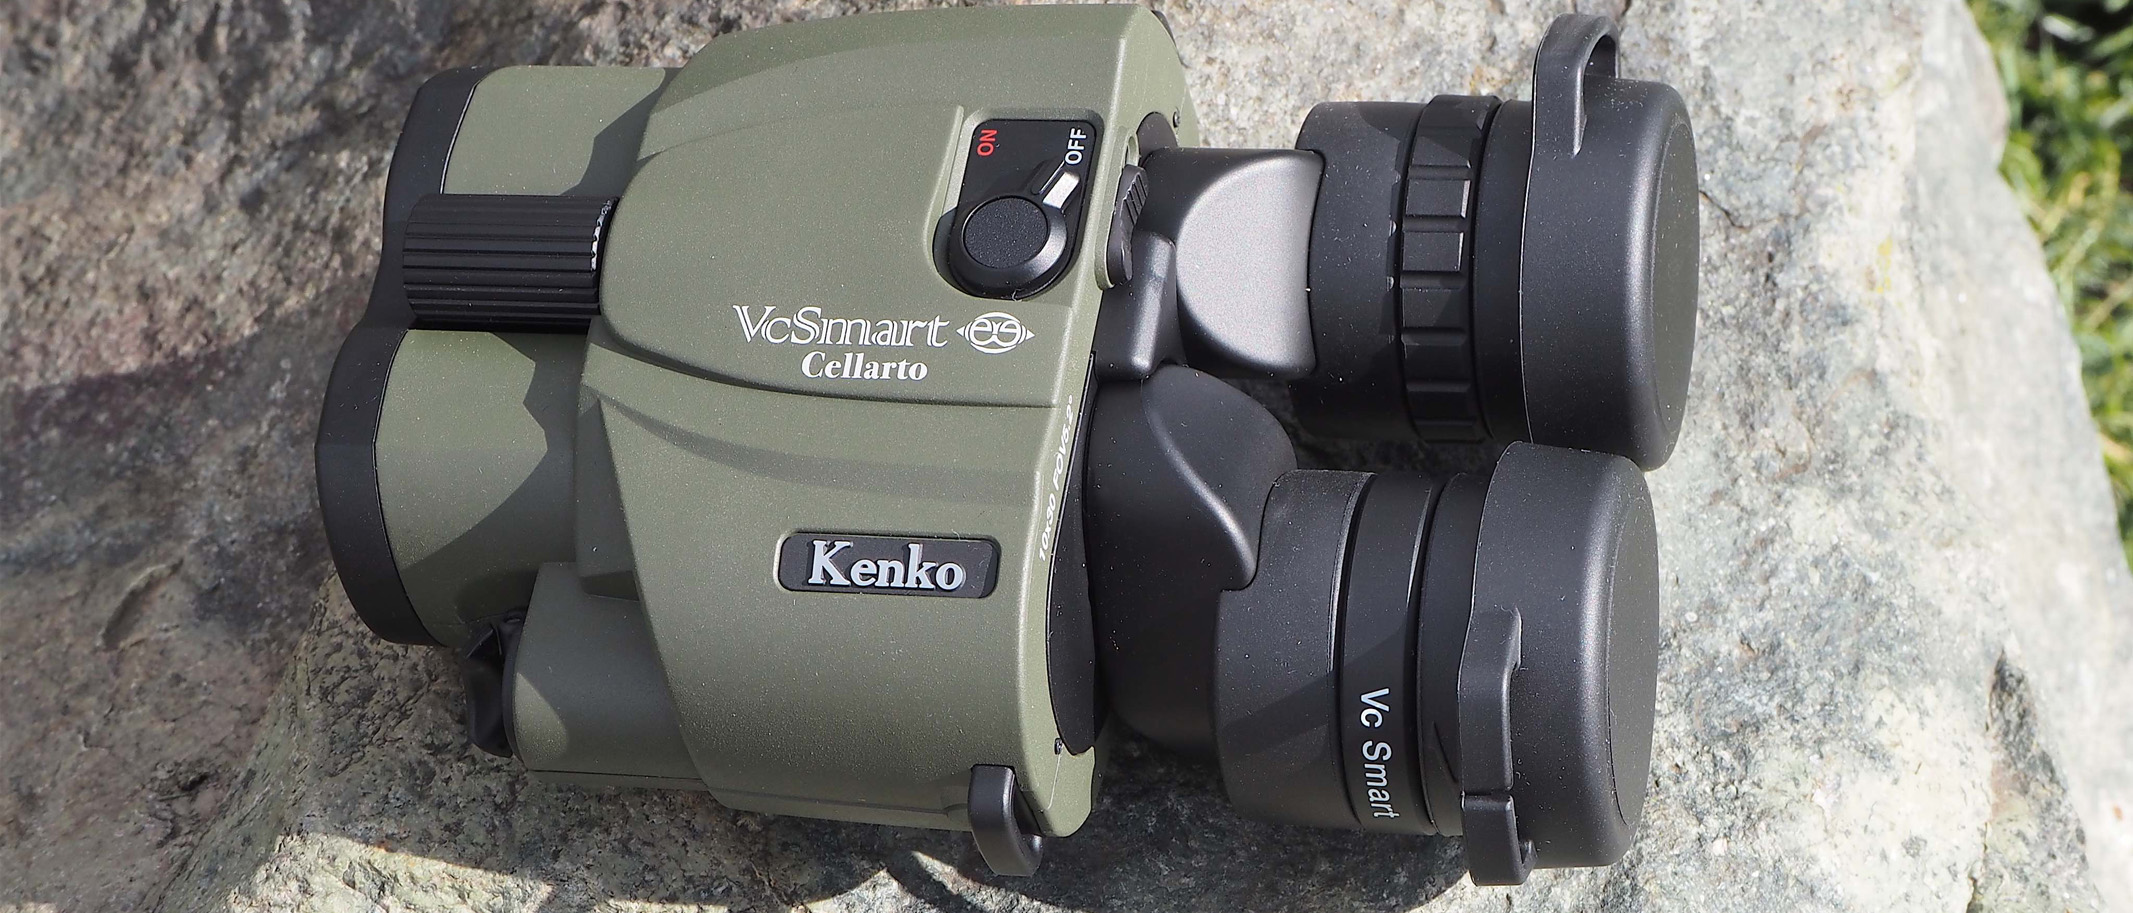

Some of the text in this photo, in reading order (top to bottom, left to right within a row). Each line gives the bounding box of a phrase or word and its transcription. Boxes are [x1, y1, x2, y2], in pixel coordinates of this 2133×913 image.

[977, 129, 998, 157] ON
[1064, 127, 1087, 165] OFF
[732, 304, 950, 347] VcSmart
[801, 350, 928, 380] Cellarto
[1039, 492, 1056, 562] 10x30
[808, 540, 964, 590] Kenko
[1360, 688, 1400, 818] Vc Smart
